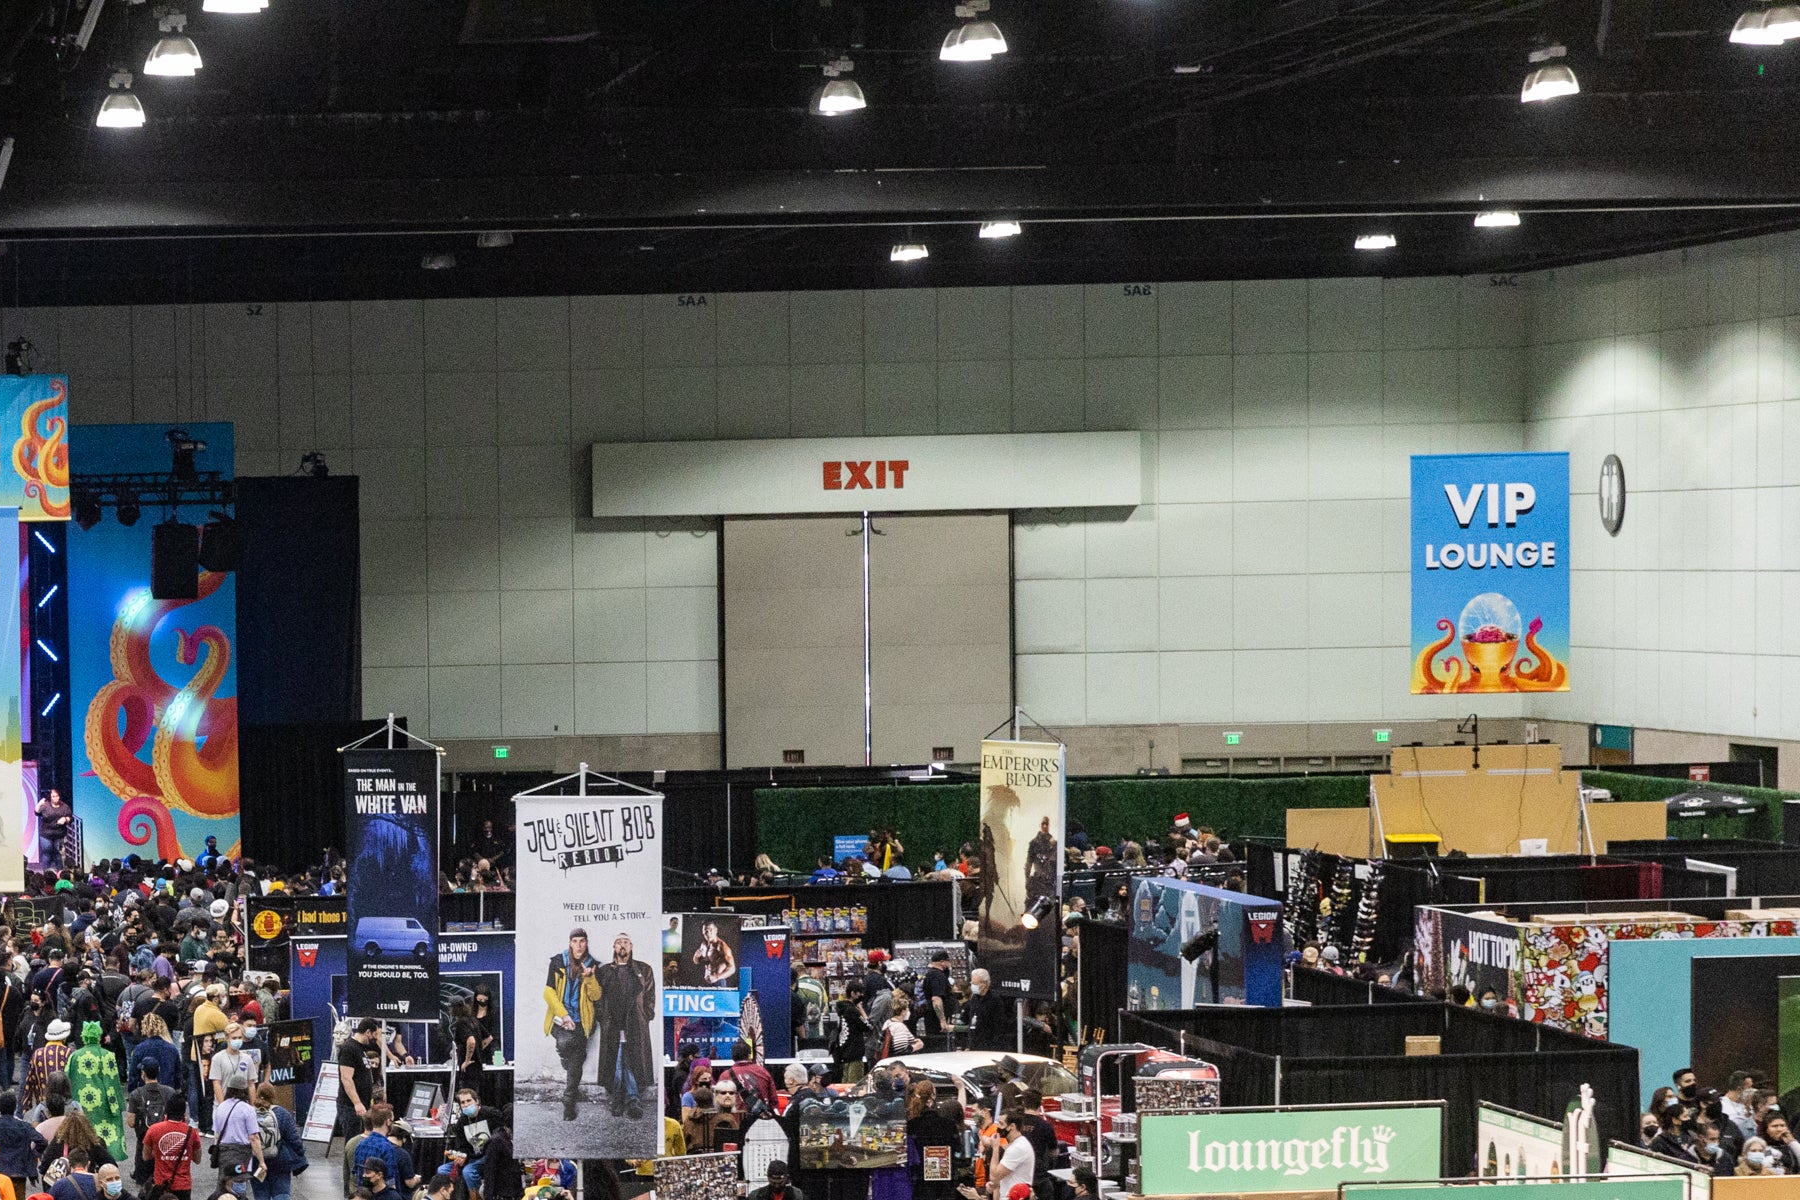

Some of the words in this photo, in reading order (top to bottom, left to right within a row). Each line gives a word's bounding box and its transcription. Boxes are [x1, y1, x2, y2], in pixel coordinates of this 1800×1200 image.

[822, 460, 909, 490] EXIT
[1443, 482, 1537, 529] VIP
[1424, 541, 1556, 572] LOUNGE
[982, 755, 1060, 776] EMPEROR'S
[356, 778, 374, 792] THE
[375, 778, 396, 792] MAN
[398, 782, 406, 791] IN
[407, 782, 417, 791] THE
[1005, 773, 1054, 789] BLADES
[355, 795, 396, 814] WHITE
[400, 794, 428, 814] VAN
[523, 818, 558, 852] JAY
[563, 808, 616, 850] SILENT
[621, 804, 656, 842] BOB
[559, 845, 624, 869] REBOOT
[302, 910, 323, 923] had
[587, 903, 608, 911] LOVE
[611, 904, 620, 912] TO
[1248, 911, 1277, 921] LEGION
[574, 914, 592, 922] TELL
[594, 913, 610, 922] YOU
[612, 913, 618, 921] A
[296, 943, 319, 951] LEGION
[763, 934, 787, 942] LEGION
[1468, 930, 1490, 966] HOT
[1490, 936, 1520, 972] TOPIC
[377, 1003, 398, 1011] LEGION
[664, 994, 716, 1013] TING
[1186, 1124, 1397, 1176] loungefly
